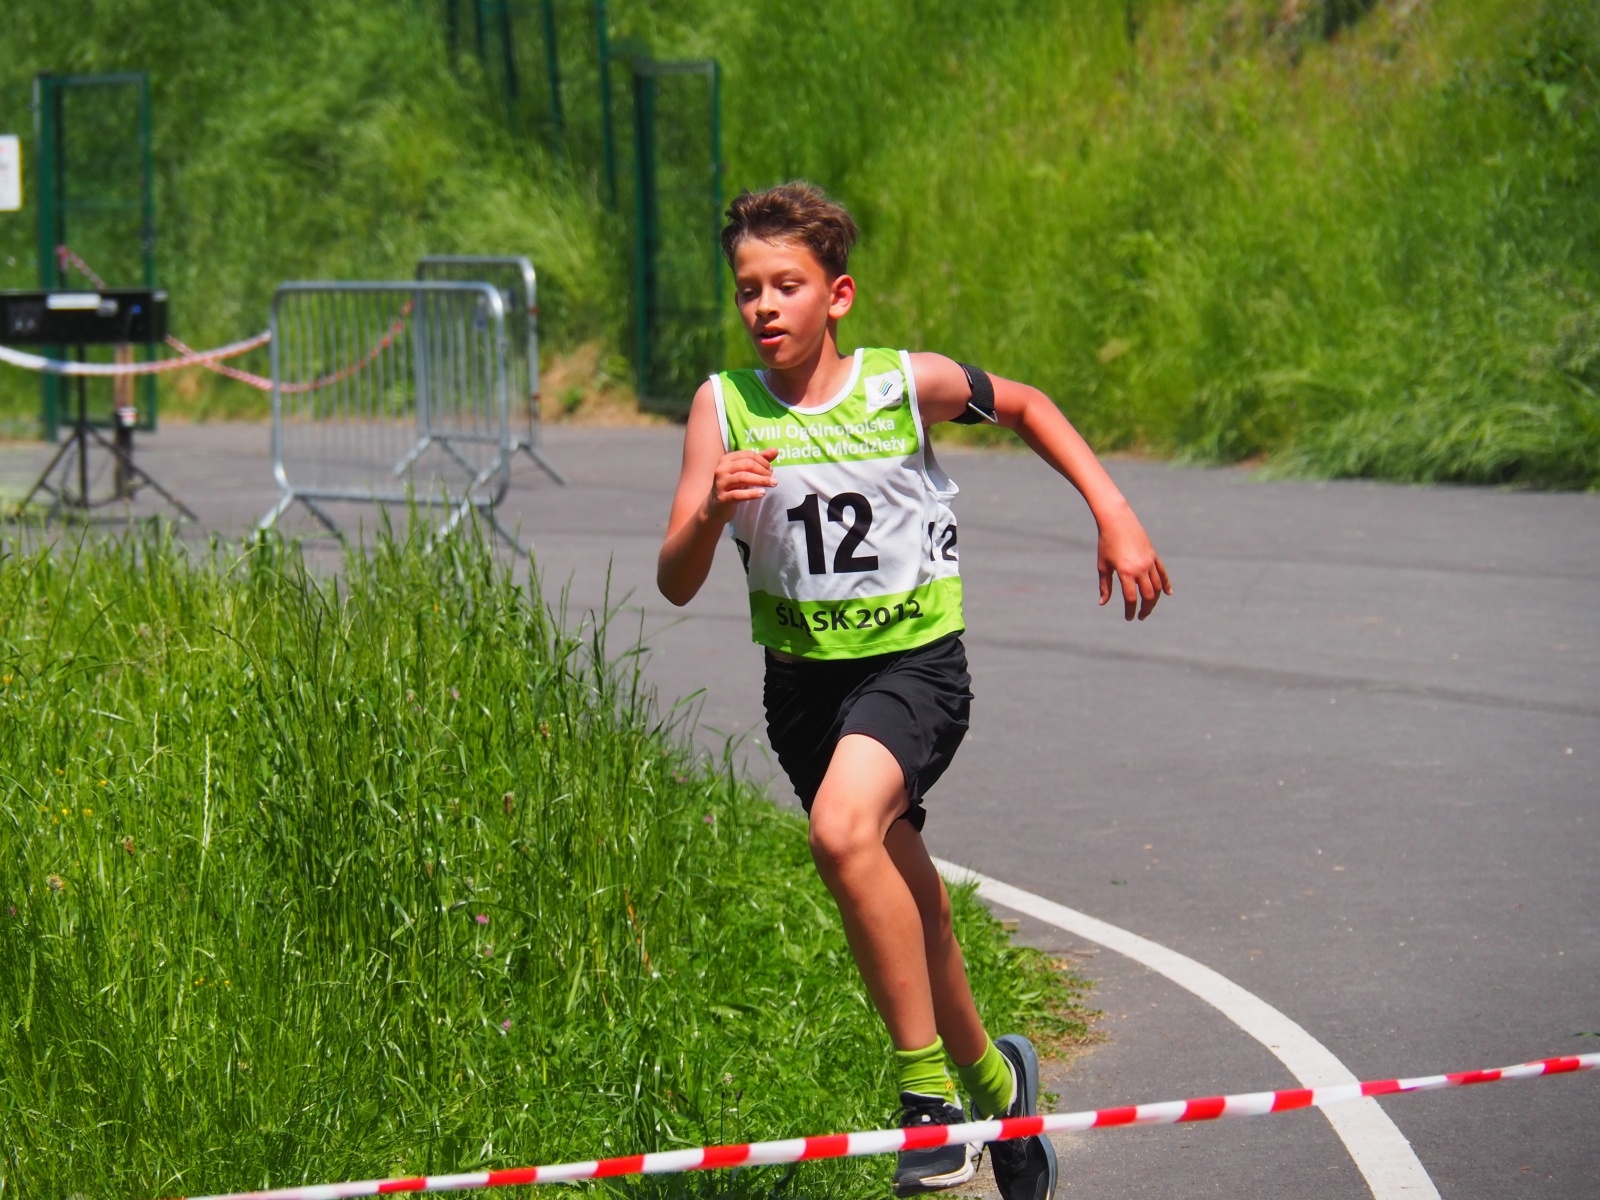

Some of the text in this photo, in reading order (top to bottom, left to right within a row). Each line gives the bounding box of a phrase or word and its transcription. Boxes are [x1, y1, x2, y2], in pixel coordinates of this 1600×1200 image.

[744, 417, 895, 444] XVIII Ogólnopolska
[825, 436, 906, 457] Młodzieży
[786, 492, 879, 575] 12
[775, 599, 924, 638] ŚLĄSK 2012
